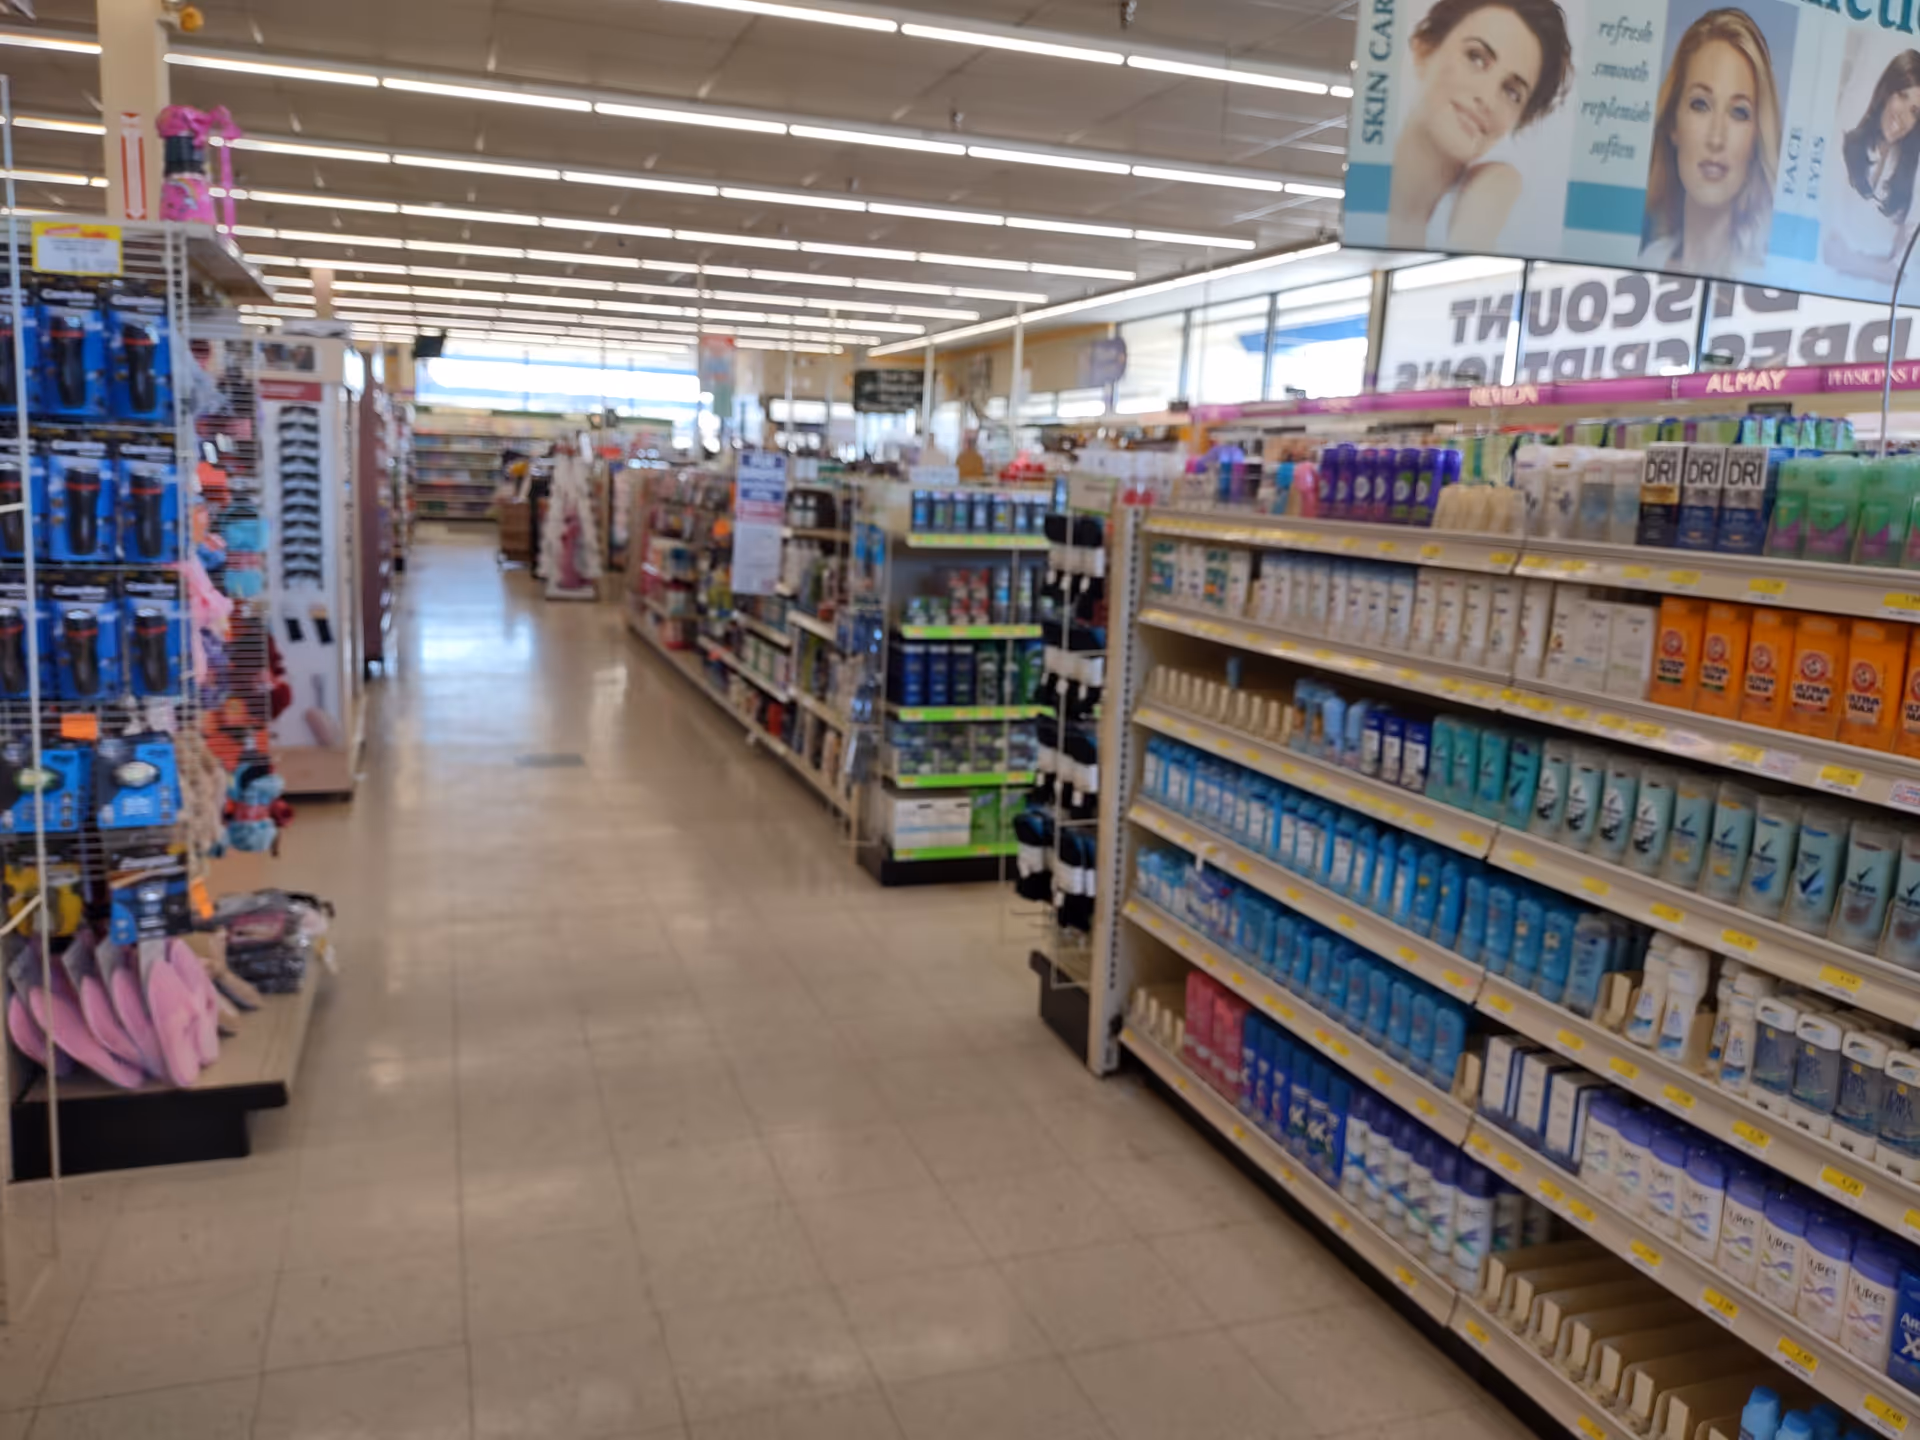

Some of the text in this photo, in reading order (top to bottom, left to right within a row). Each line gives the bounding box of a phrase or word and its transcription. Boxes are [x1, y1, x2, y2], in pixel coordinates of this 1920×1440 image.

[1599, 15, 1653, 45] refresh
[1591, 60, 1649, 82] smooth
[1362, 70, 1389, 145] SKIN
[1581, 96, 1651, 125] replenish
[1589, 133, 1636, 164] soften
[1783, 127, 1803, 195] FACE
[1706, 369, 1788, 393] ALMAY
[1644, 460, 1679, 484] DRI
[1686, 461, 1720, 485] DRI
[1728, 461, 1762, 487] DRI
